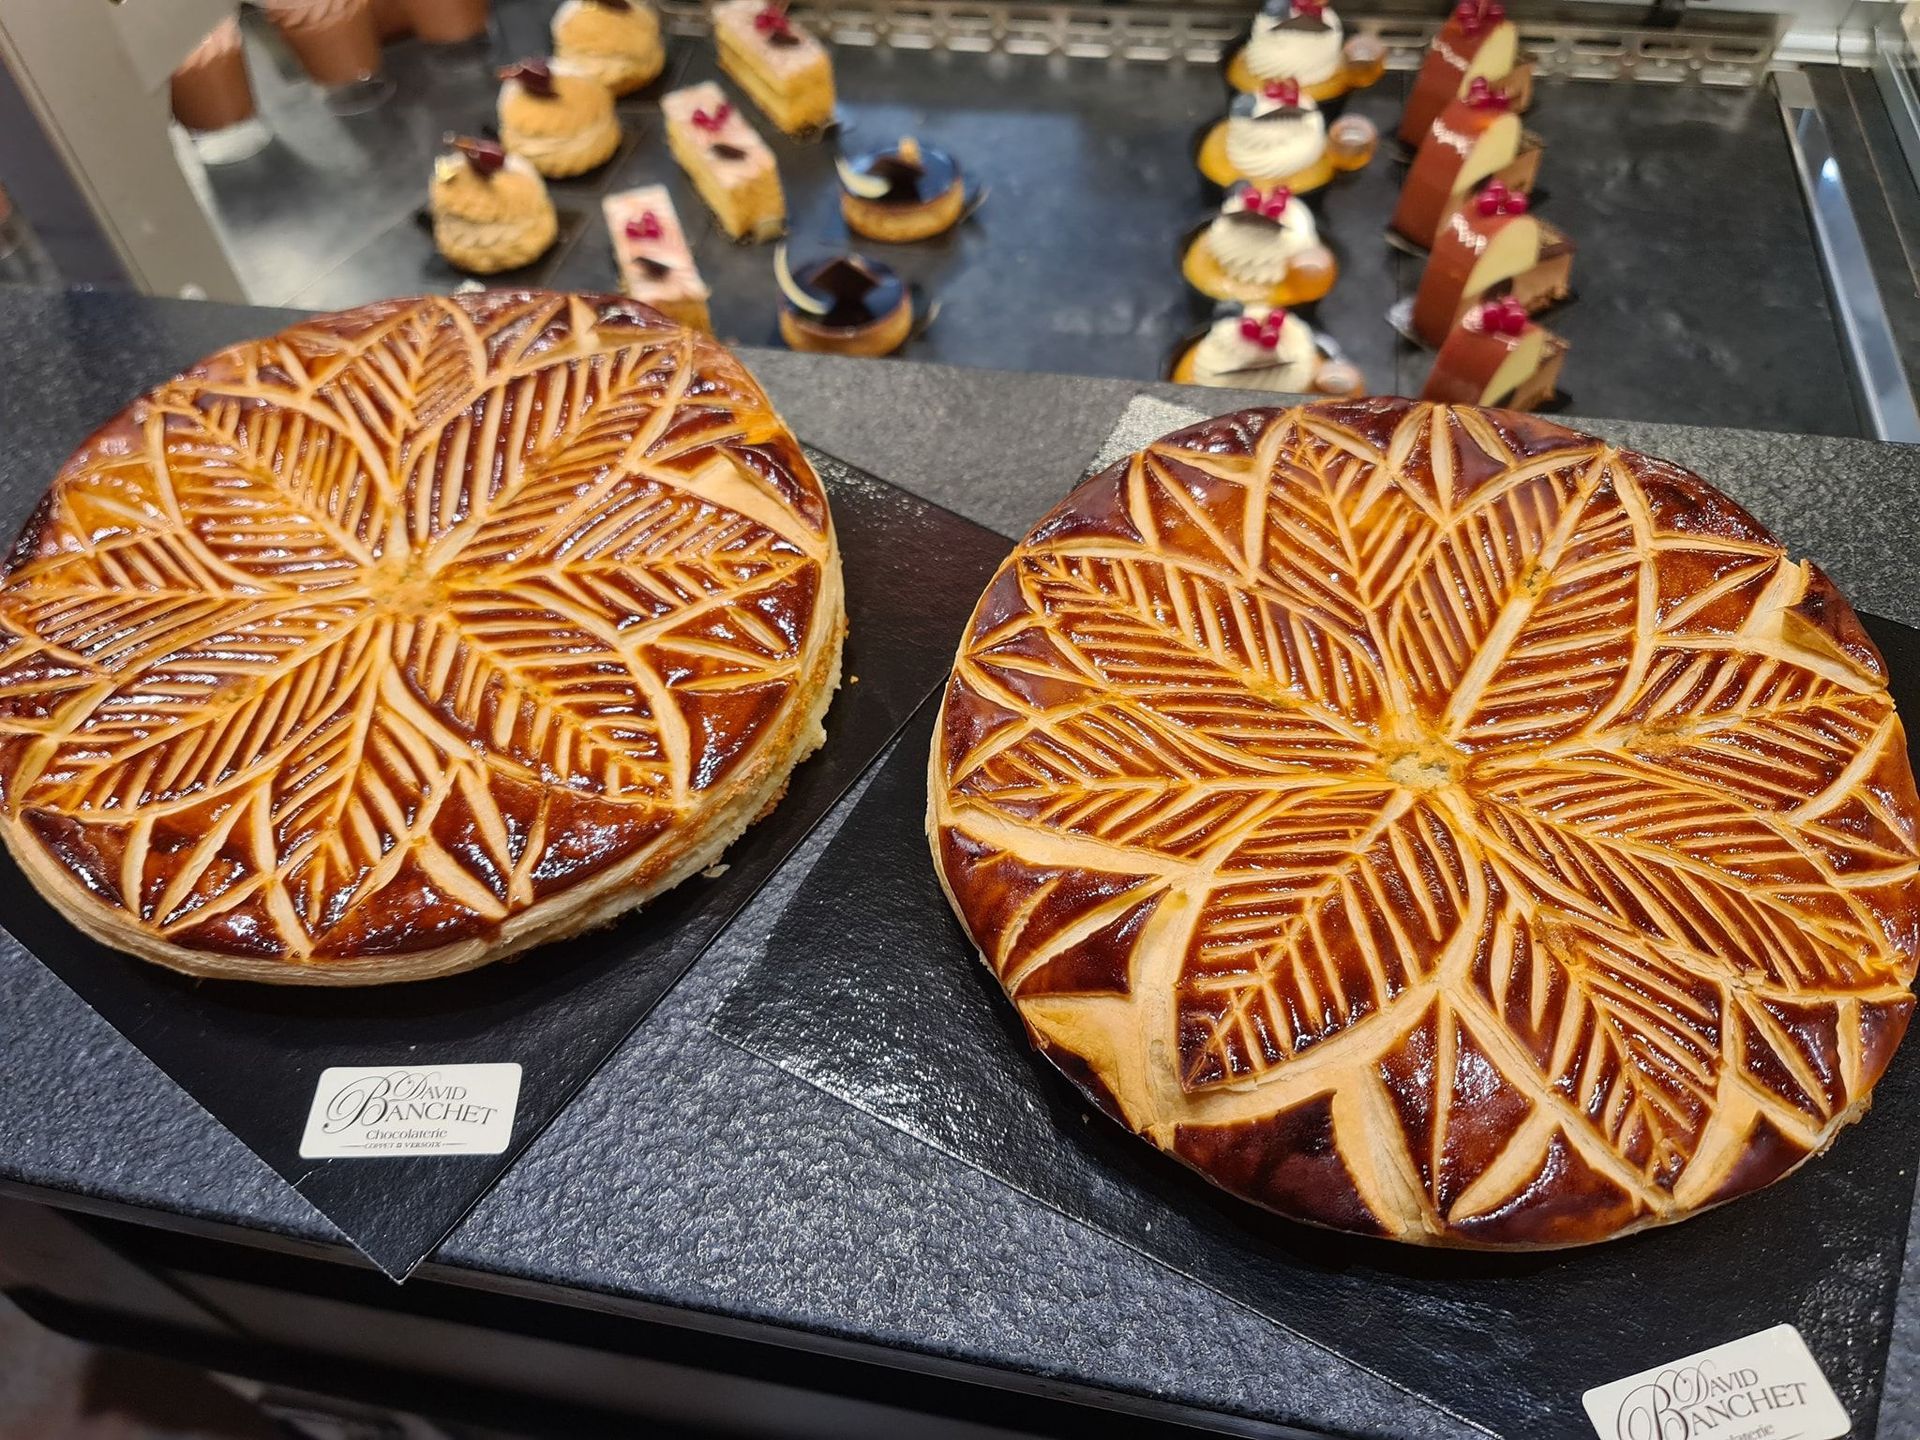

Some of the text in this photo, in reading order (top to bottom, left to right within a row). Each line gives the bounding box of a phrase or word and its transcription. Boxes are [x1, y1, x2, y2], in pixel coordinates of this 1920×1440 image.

[322, 1070, 498, 1134] BANCHET
[394, 1071, 467, 1101] DAVID
[366, 1128, 448, 1140] Chocolaterie
[1616, 1370, 1807, 1440] BANCHET
[1673, 1359, 1759, 1411] DAVID
